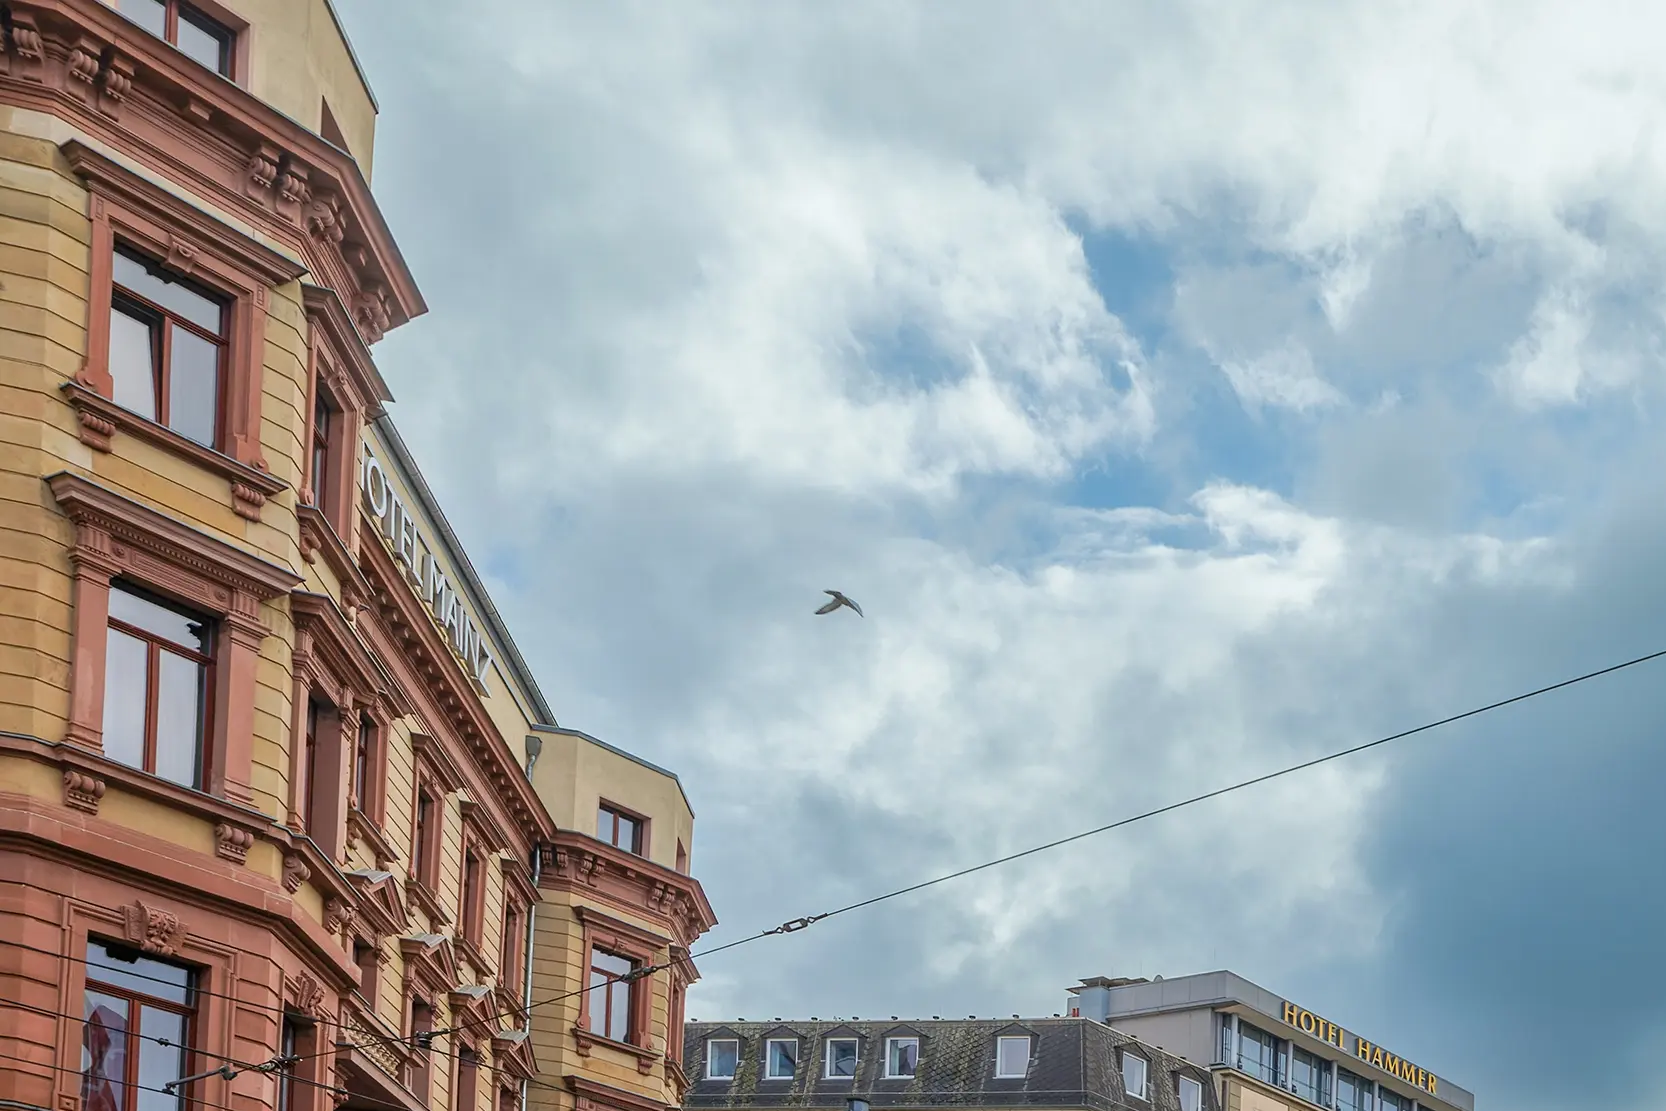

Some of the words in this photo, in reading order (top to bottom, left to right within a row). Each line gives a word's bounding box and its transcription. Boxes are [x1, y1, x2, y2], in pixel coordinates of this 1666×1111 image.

[422, 553, 494, 698] MAINZ
[1282, 1000, 1347, 1050] HOTEL
[1356, 1039, 1437, 1094] HAMMER
